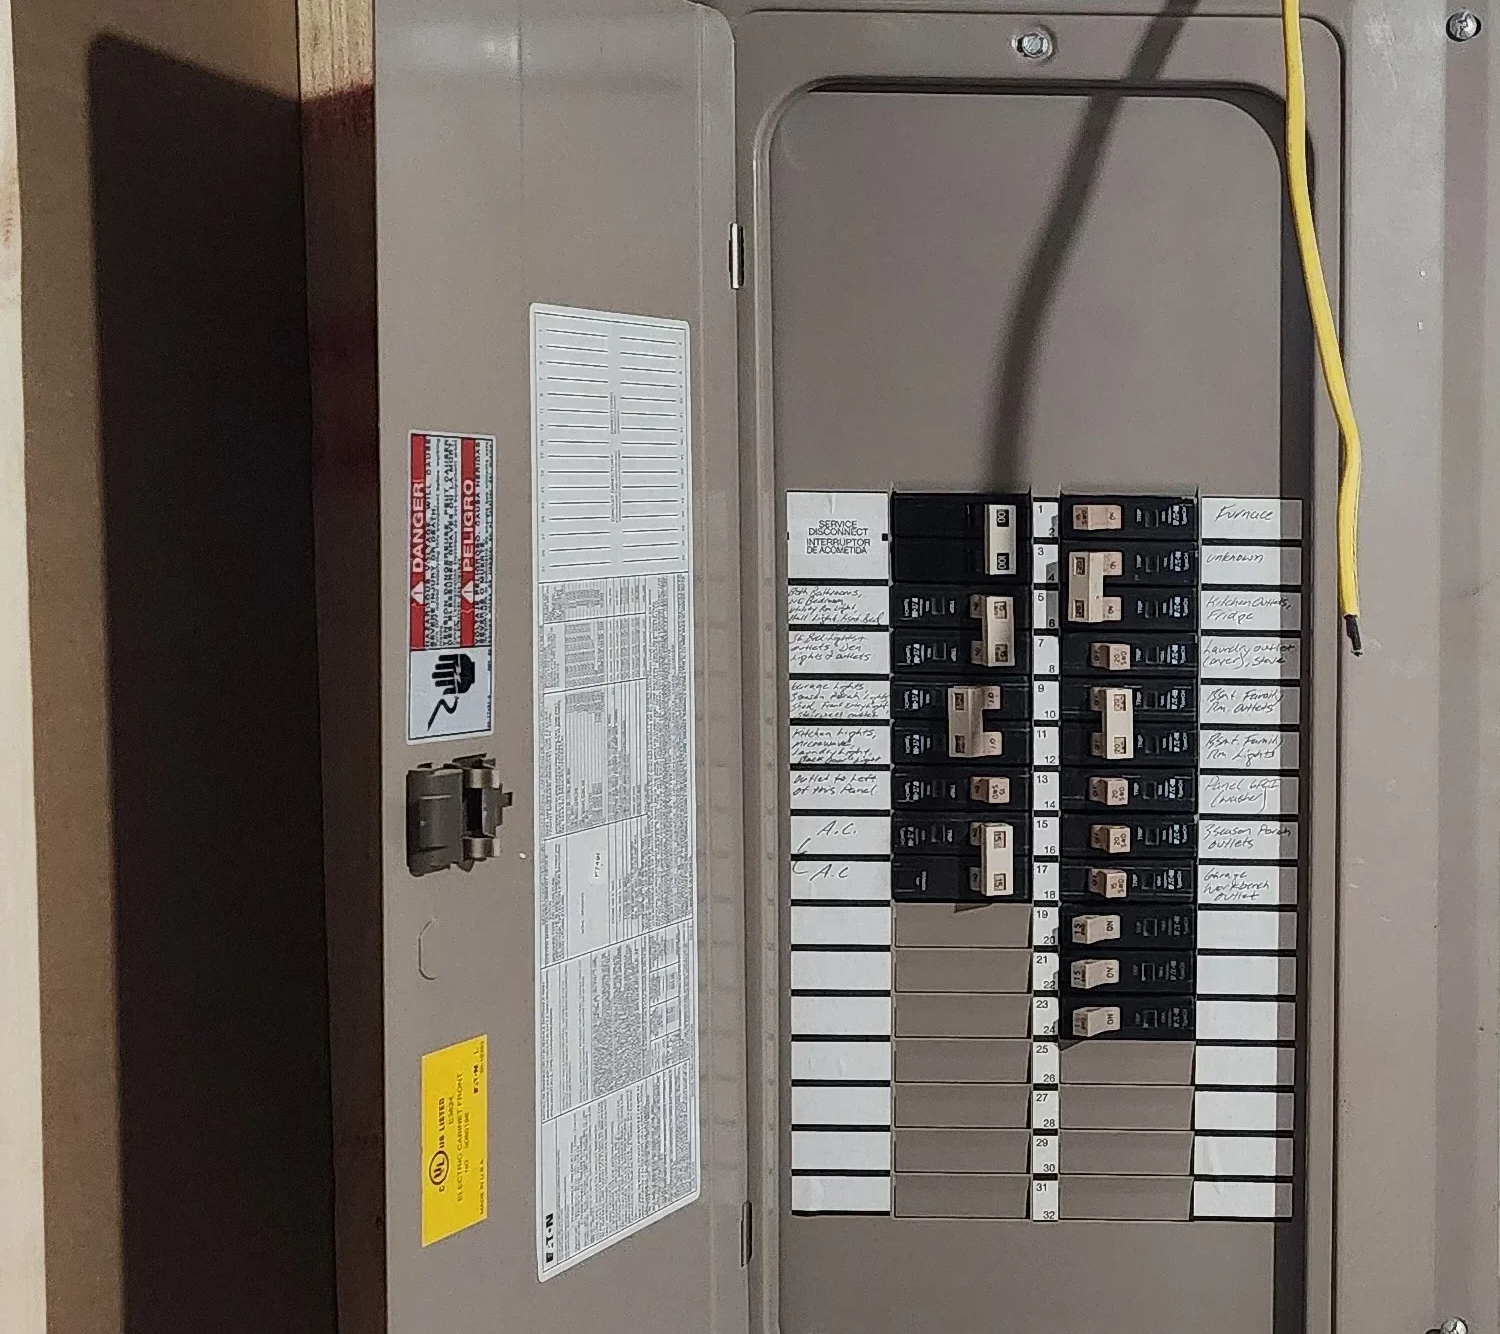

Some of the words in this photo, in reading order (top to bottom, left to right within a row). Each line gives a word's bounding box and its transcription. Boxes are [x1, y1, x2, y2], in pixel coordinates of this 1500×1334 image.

[1038, 505, 1043, 514] 1
[412, 482, 424, 573] DANGER
[463, 479, 473, 572] PELIGRO
[818, 520, 858, 529] SERVICE
[808, 527, 869, 536] DISCONNECT
[1048, 527, 1055, 536] 2
[806, 538, 871, 547] INTERRUPTOR
[806, 546, 818, 554] DE
[819, 546, 868, 555] ACOMETIDA
[1037, 547, 1045, 556] 3
[1047, 573, 1055, 582] 4
[1037, 592, 1045, 602] 5
[1048, 618, 1056, 628] 6
[1037, 638, 1045, 647] 7
[1048, 664, 1055, 674] 8
[1037, 684, 1045, 693] 9
[1044, 709, 1056, 719] 10
[1036, 729, 1047, 739] 11
[1044, 755, 1056, 764] 12
[1036, 774, 1049, 784] 13
[1044, 800, 1056, 809] 14
[1036, 820, 1049, 830] 15
[1044, 845, 1056, 855] 16
[1036, 865, 1049, 874] 17
[1043, 890, 1056, 899] 18
[1036, 910, 1049, 919] 19
[1106, 920, 1114, 932] ON
[1043, 935, 1056, 945] 20
[1036, 955, 1048, 965] 21
[1106, 966, 1114, 979] ON
[1043, 980, 1056, 990] 22
[1036, 1000, 1049, 1009] 23
[1106, 1013, 1114, 1026] ON
[1043, 1025, 1056, 1034] 24
[1035, 1045, 1049, 1055] 25
[1043, 1073, 1056, 1083] 26
[1035, 1093, 1049, 1103] 27
[1043, 1118, 1056, 1129] 28
[1035, 1138, 1049, 1148] 29
[1043, 1163, 1056, 1173] 30
[1035, 1182, 1049, 1193] 31
[1043, 1210, 1056, 1220] 32
